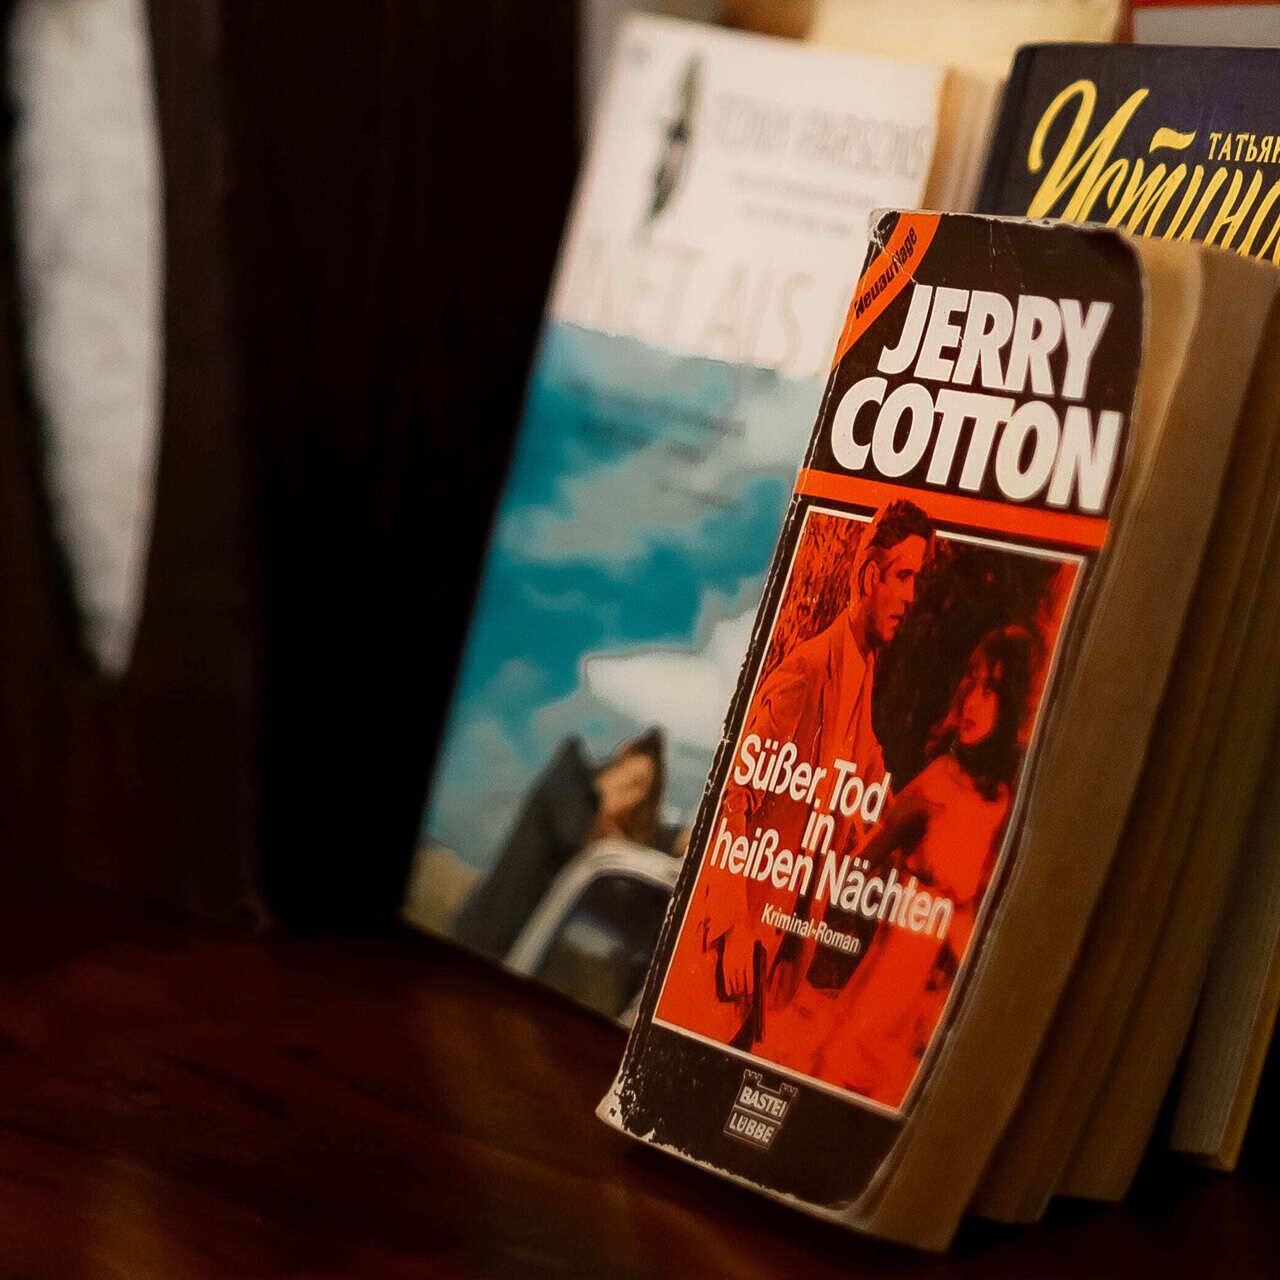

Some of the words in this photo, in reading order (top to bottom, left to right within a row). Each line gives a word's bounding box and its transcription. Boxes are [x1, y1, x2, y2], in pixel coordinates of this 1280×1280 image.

[853, 226, 918, 320] Neuauflage
[876, 282, 1113, 401] JERRY
[830, 375, 1124, 514] COTTON
[732, 732, 828, 805] Süßer
[830, 758, 892, 825] Tod
[800, 798, 834, 857] in
[709, 817, 815, 898] heißen
[815, 856, 954, 941] Nächten
[760, 902, 861, 954] Kriminal-Roman
[727, 1111, 776, 1144] LÜBBE
[738, 1086, 789, 1119] BASTEI
